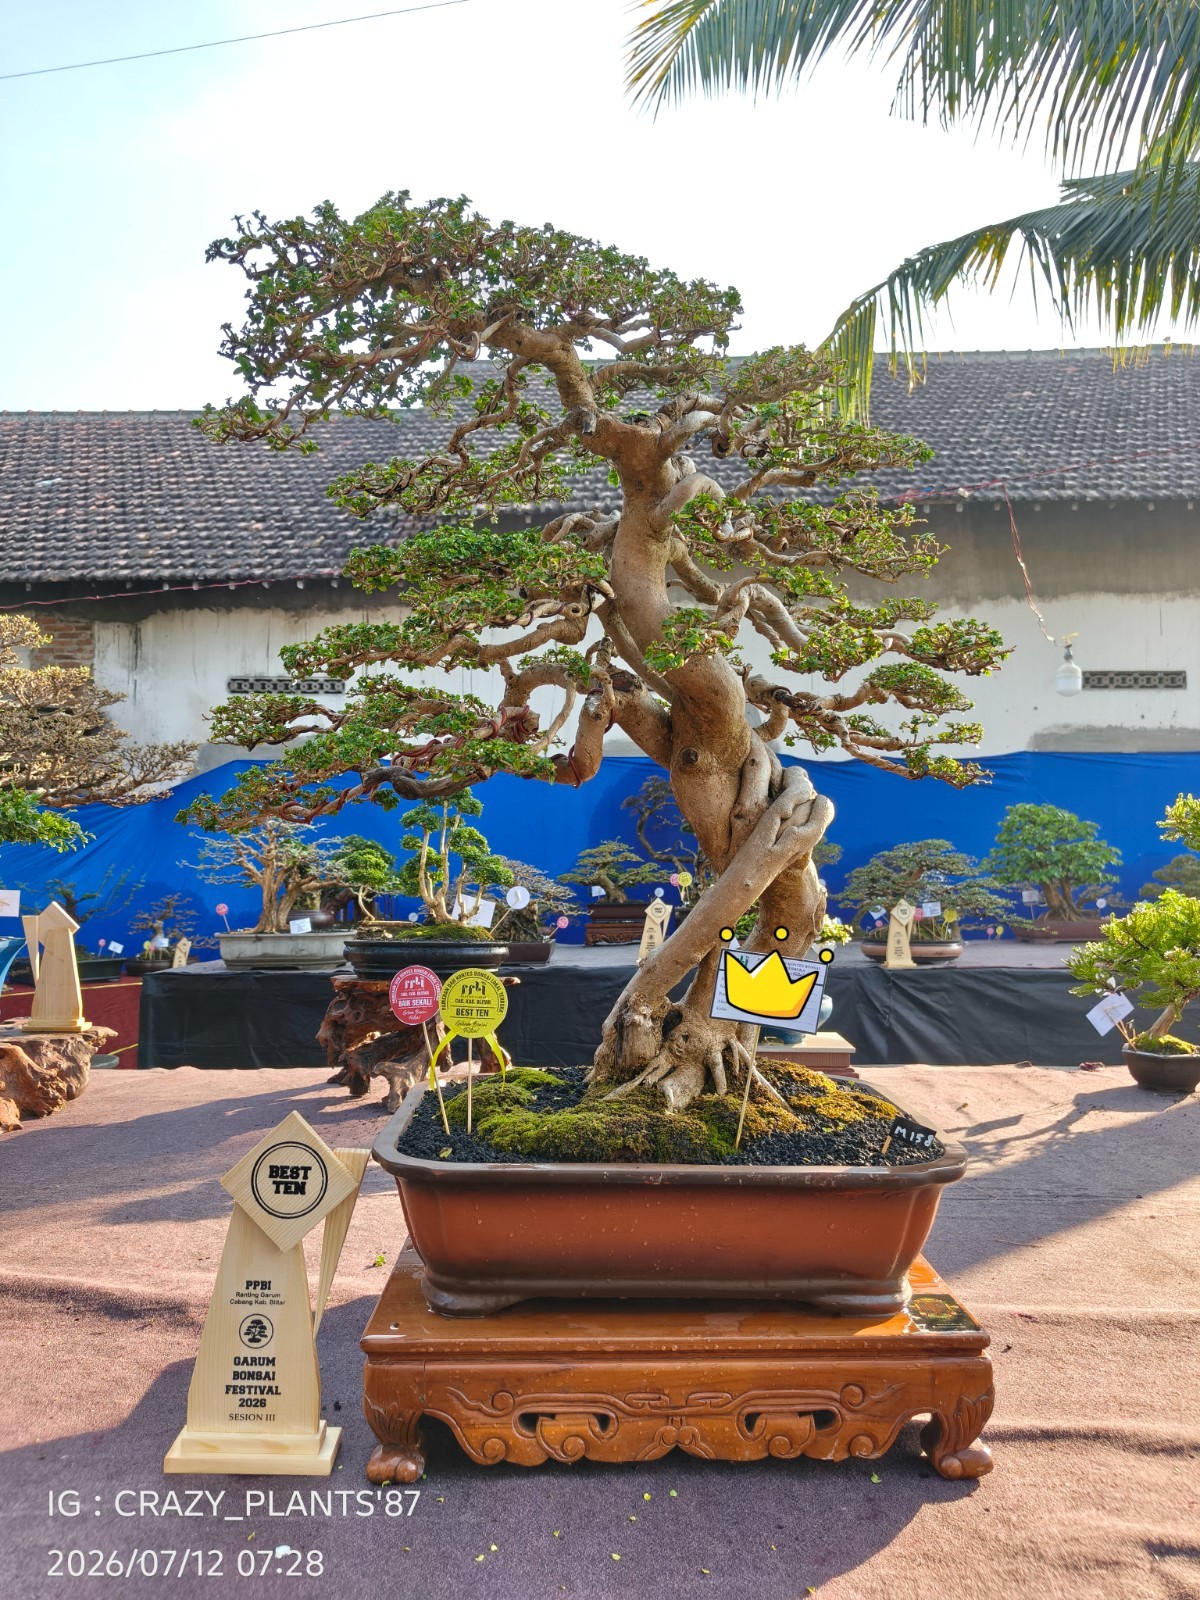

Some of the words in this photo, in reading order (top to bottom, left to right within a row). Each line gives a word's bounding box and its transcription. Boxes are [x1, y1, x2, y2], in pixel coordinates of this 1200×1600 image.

[412, 998, 432, 1006] SEKALI
[456, 1008, 474, 1017] BEST
[475, 1008, 490, 1017] TEN
[894, 1125, 934, 1147] M158
[268, 1165, 312, 1180] BEST
[272, 1181, 307, 1195] TEN
[245, 1280, 272, 1290] PPBI
[235, 1291, 259, 1299] Ranting
[229, 1298, 253, 1306] Cabang
[233, 1356, 276, 1366] GARUM
[232, 1370, 276, 1381] BONSAI
[225, 1384, 281, 1395] FESTIVAL
[238, 1398, 267, 1408] 2026
[228, 1413, 263, 1421] SESION
[265, 1413, 275, 1421] III
